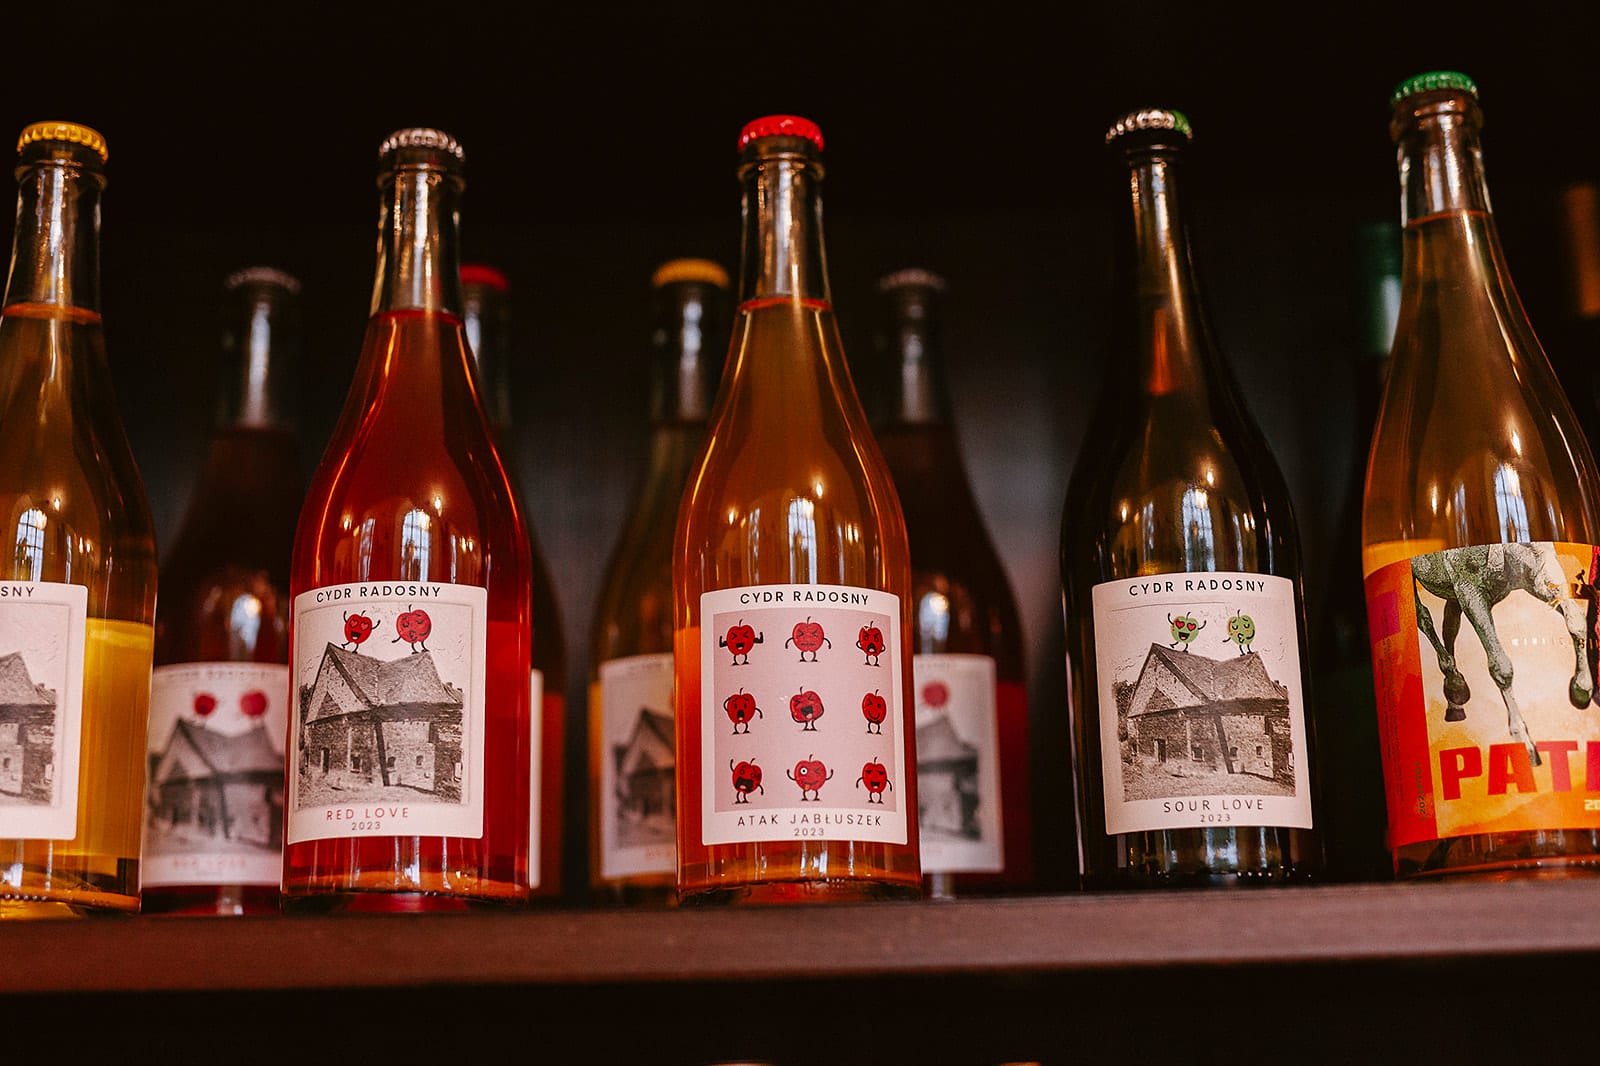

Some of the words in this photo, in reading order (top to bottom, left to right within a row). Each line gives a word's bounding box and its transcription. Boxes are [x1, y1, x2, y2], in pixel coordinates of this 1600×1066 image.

[316, 587, 352, 603] CYDR
[360, 585, 441, 597] RADOSNY
[1129, 581, 1174, 596] CYDR
[1185, 579, 1265, 592] RADOSNY
[740, 591, 784, 604] CYDR
[793, 591, 869, 605] RADOSNY
[1163, 800, 1210, 813] SOUR
[1222, 799, 1264, 810] LOVE
[326, 808, 355, 821] RED
[365, 807, 409, 819] LOVE
[737, 814, 779, 826] ATAK
[790, 813, 881, 826] JABŁUSZEK
[1200, 814, 1231, 822] 2023
[351, 821, 381, 831] 2023
[794, 828, 825, 837] 2023
